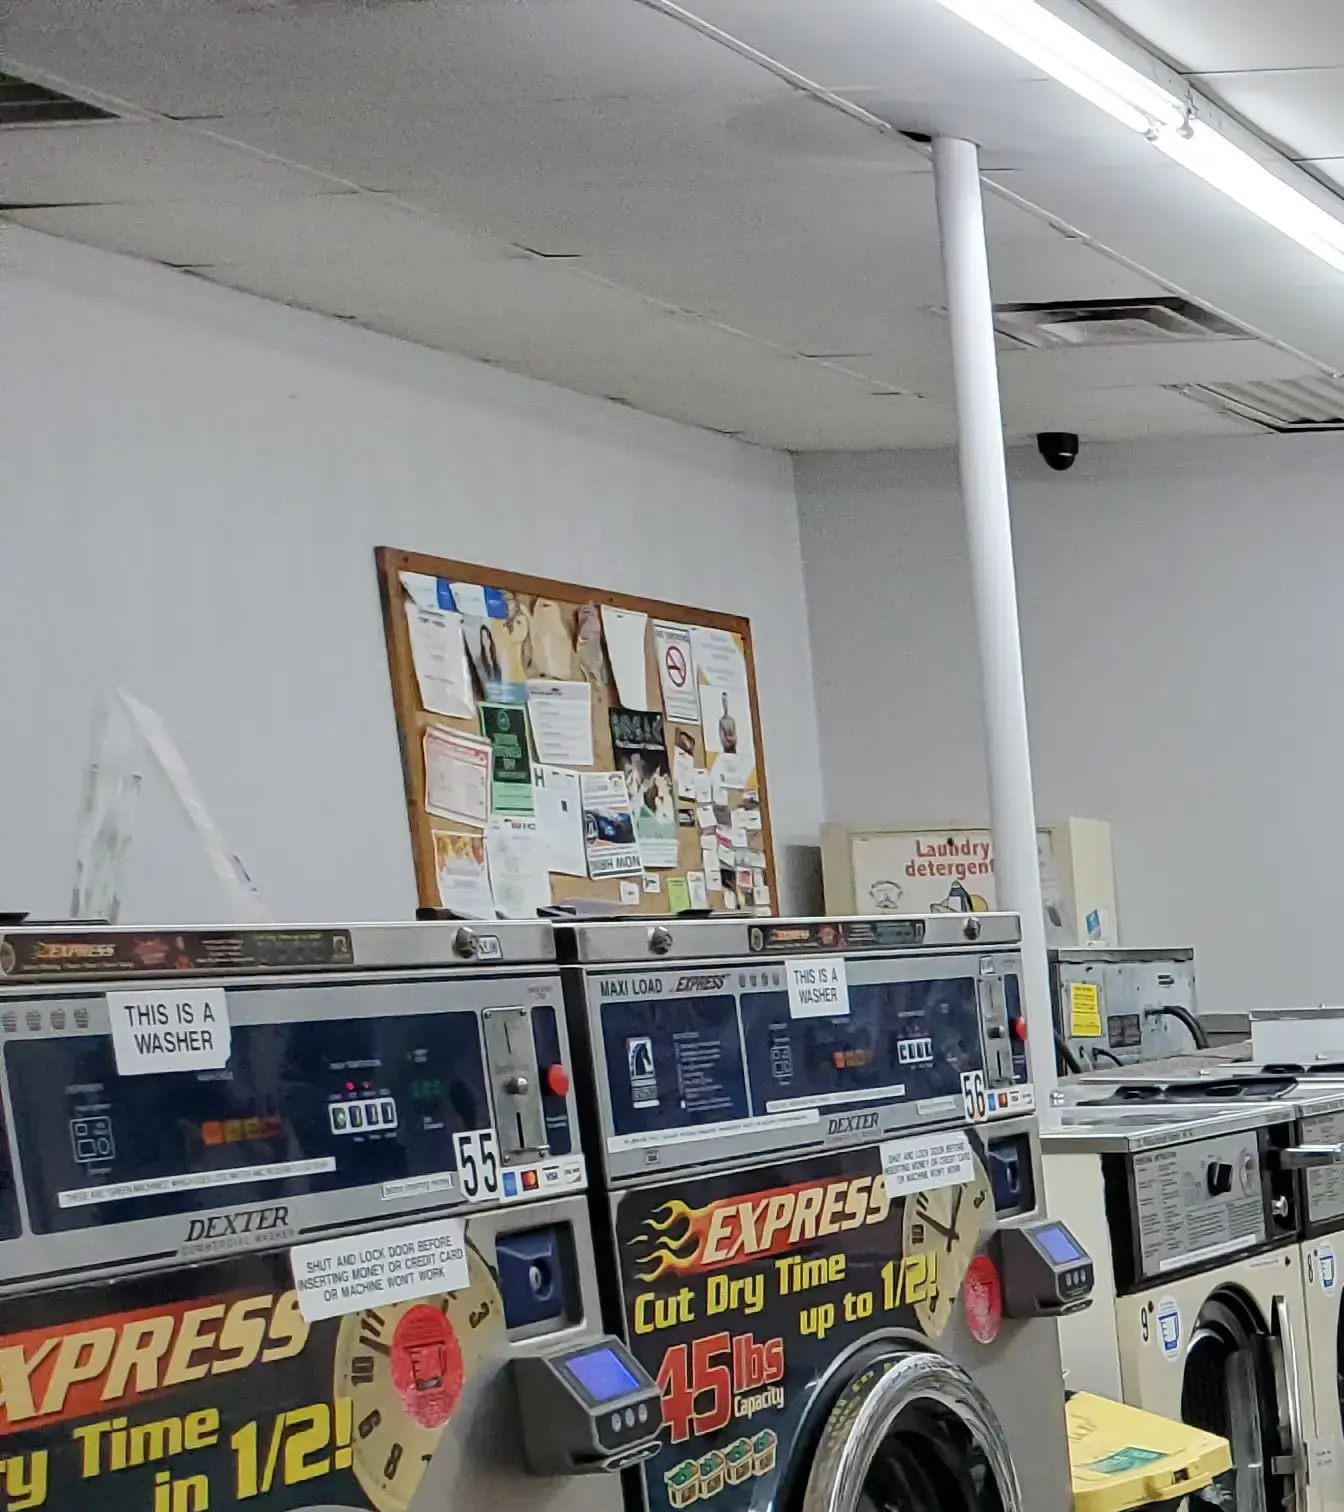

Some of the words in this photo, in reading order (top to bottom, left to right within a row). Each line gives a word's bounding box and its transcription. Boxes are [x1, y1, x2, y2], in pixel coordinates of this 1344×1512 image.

[533, 768, 546, 789] H
[915, 838, 990, 861] Laundry
[599, 980, 630, 997] MAXI
[632, 978, 663, 995] LOAD
[675, 973, 726, 993] EXPRESS
[793, 968, 816, 985] THIS
[818, 968, 829, 983] IS
[831, 967, 839, 981] A
[123, 1003, 169, 1027] THIS
[175, 1002, 194, 1025] IS
[203, 1001, 216, 1023] A
[797, 987, 838, 1005] WASHER
[133, 1030, 213, 1055] WASHER
[962, 1073, 986, 1120] 56
[828, 1112, 880, 1135] DEXTER
[457, 1131, 499, 1198] 55
[184, 1205, 290, 1243] DEXTER
[700, 1173, 893, 1266] EXPRESS
[298, 1271, 350, 1292] INSERTING
[351, 1263, 385, 1281] MONEY
[388, 1260, 402, 1273] OR
[404, 1253, 437, 1270] CREDIT
[439, 1248, 464, 1263] CARD
[306, 1257, 333, 1273] SHUT
[337, 1254, 357, 1268] AND
[359, 1247, 386, 1264] LOCK
[387, 1242, 416, 1258] DOOR
[417, 1235, 453, 1253] BEFORE
[1307, 1252, 1315, 1284] 8
[323, 1288, 338, 1302] OR
[340, 1278, 385, 1298] MACHINE
[417, 1267, 447, 1282] WORK
[634, 1287, 696, 1336] Cut
[706, 1273, 766, 1316] Dry
[775, 1252, 847, 1296] Time
[799, 1300, 836, 1341] up
[842, 1290, 874, 1322] to
[879, 1251, 939, 1311] 1/2!
[1139, 1305, 1150, 1343] 9
[0, 1294, 320, 1424] XPRESS
[733, 1383, 786, 1420] Capacity
[73, 1407, 220, 1479] Time
[231, 1395, 353, 1501] 1/2!
